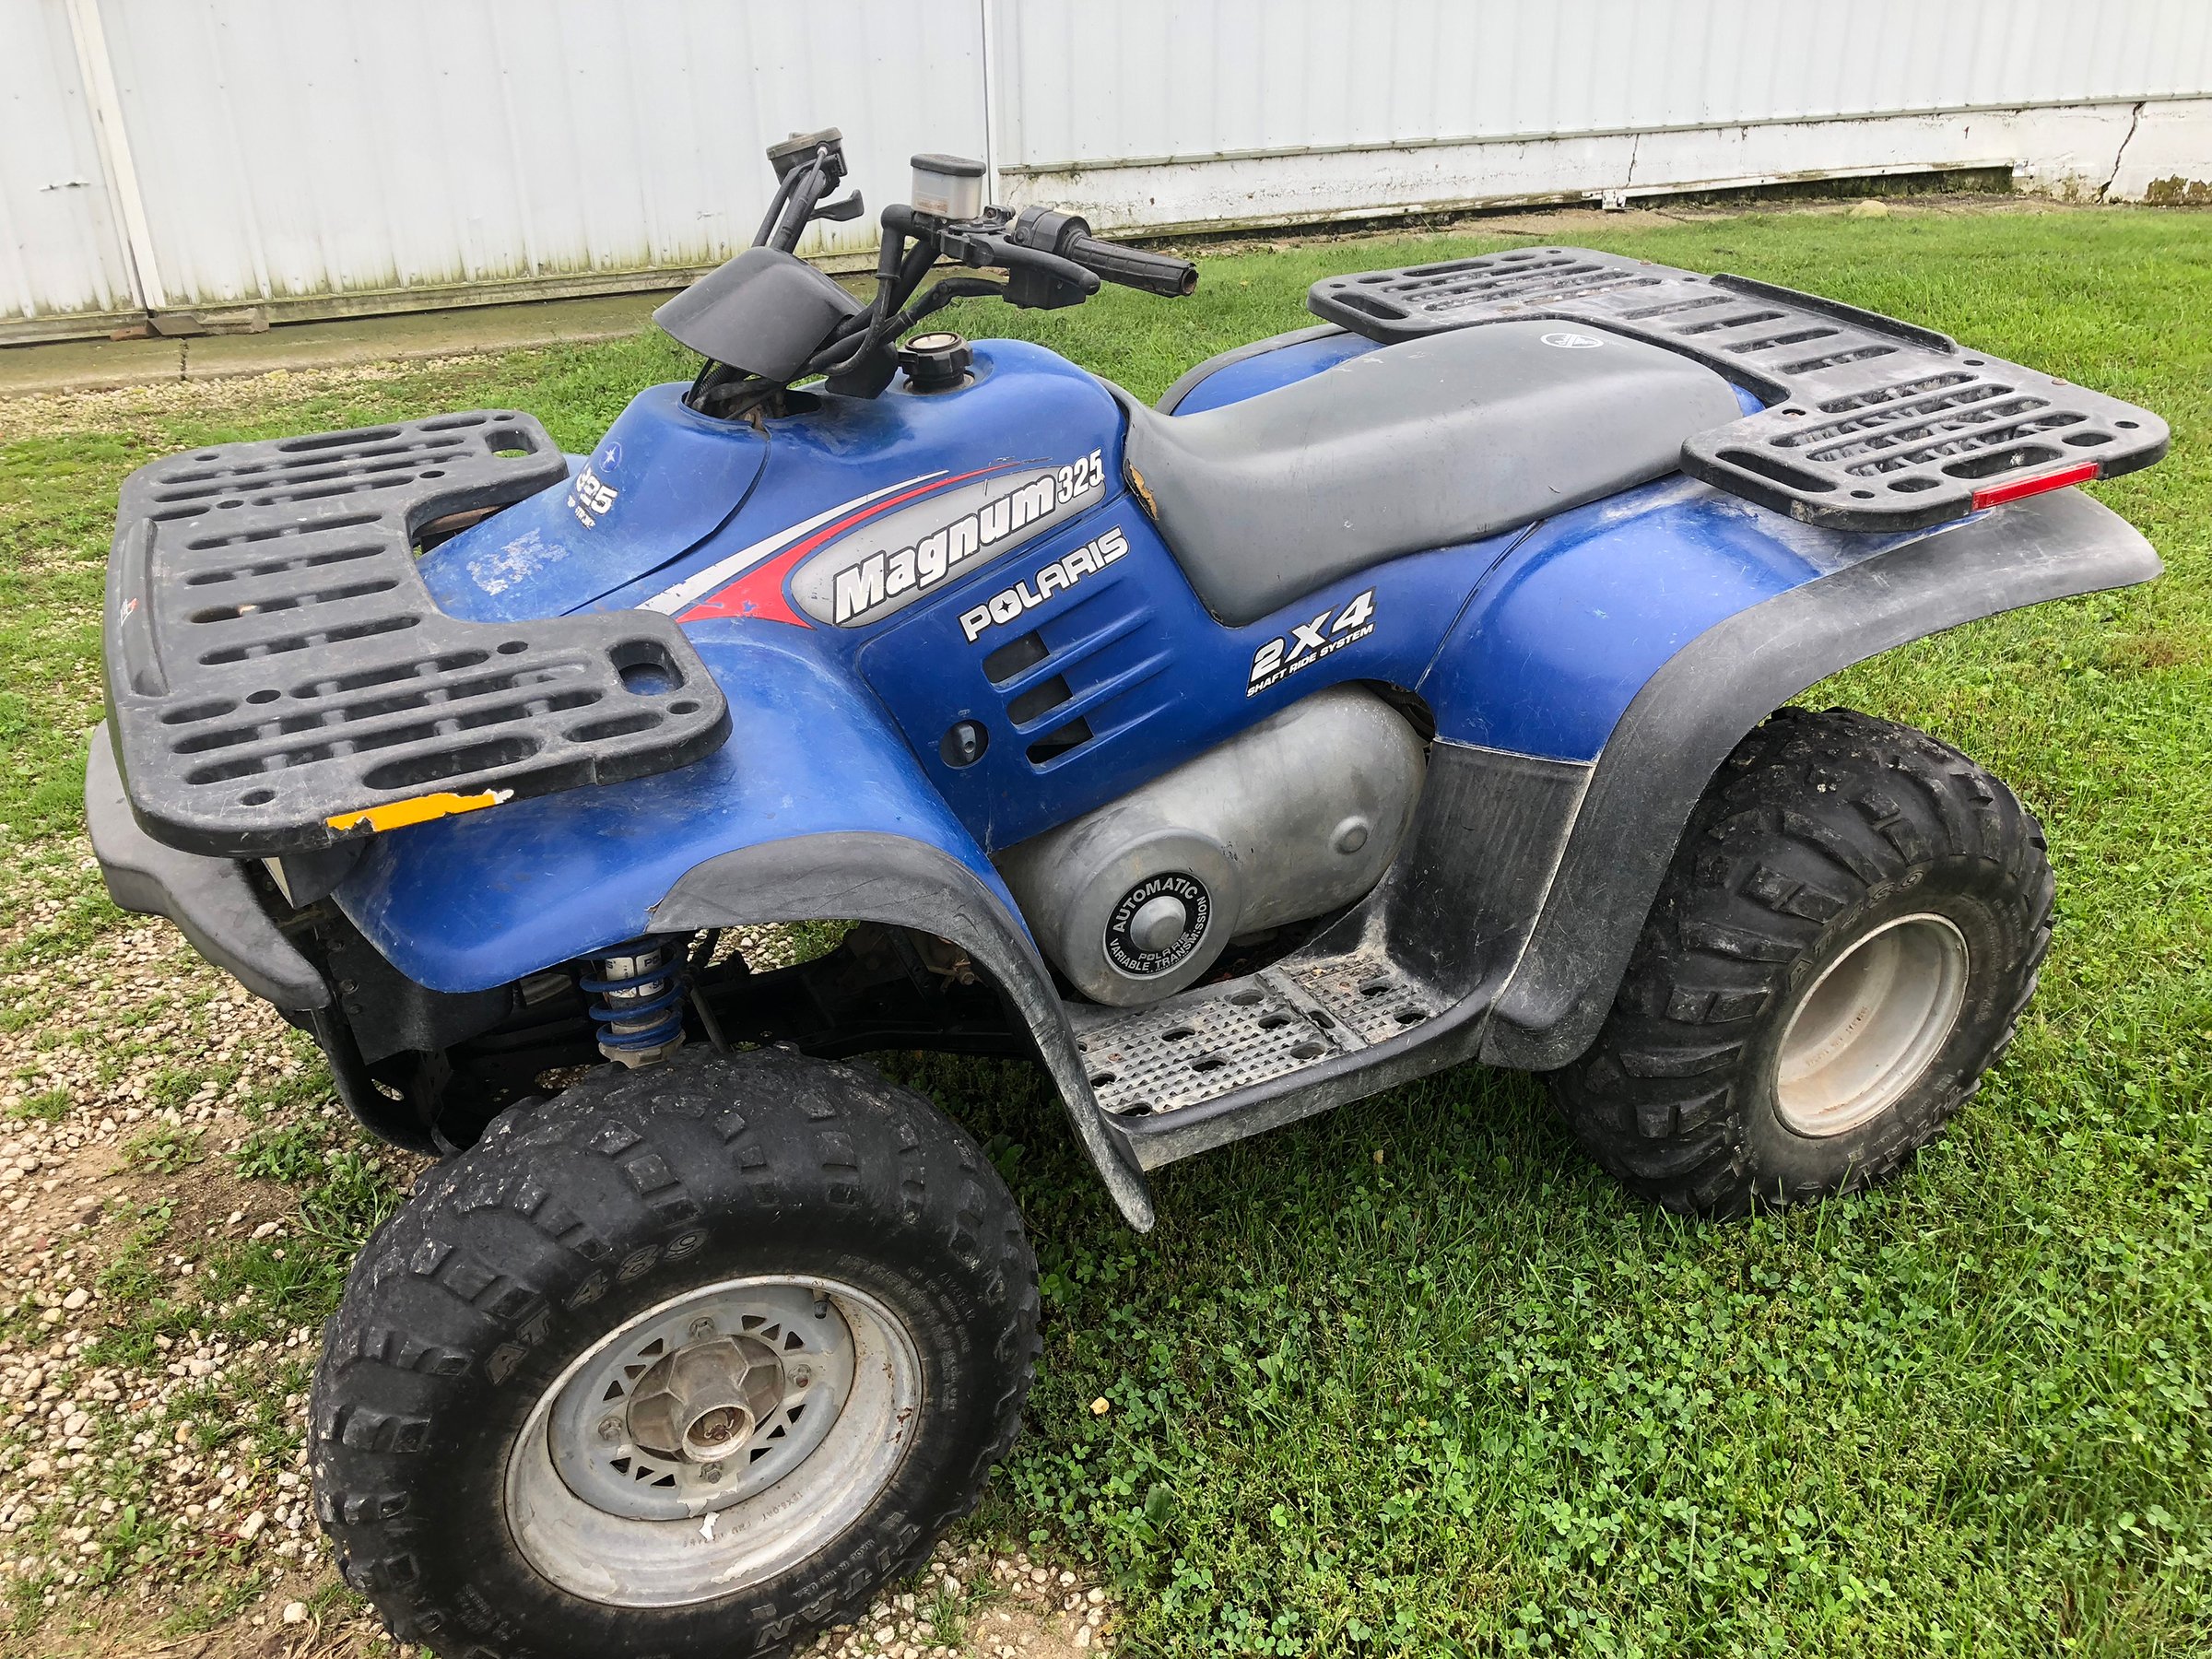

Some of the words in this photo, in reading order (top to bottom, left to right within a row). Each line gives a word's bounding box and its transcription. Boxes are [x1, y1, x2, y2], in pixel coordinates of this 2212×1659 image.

[833, 476, 1056, 625] Magnum
[1056, 449, 1104, 504] 325
[958, 525, 1131, 644] POLARIS
[1246, 669, 1287, 698] SHAFT
[1288, 652, 1317, 675] RIDE
[1319, 623, 1374, 658] SYSTEM
[1110, 937, 1150, 971] VARIABLE
[1154, 896, 1207, 969] TRANSMISSION
[1112, 877, 1198, 933] AUTOMATIC
[484, 1300, 551, 1387] AT
[565, 1228, 711, 1312] 489
[751, 1523, 923, 1650] TITAN
[850, 1538, 876, 1561] MADE
